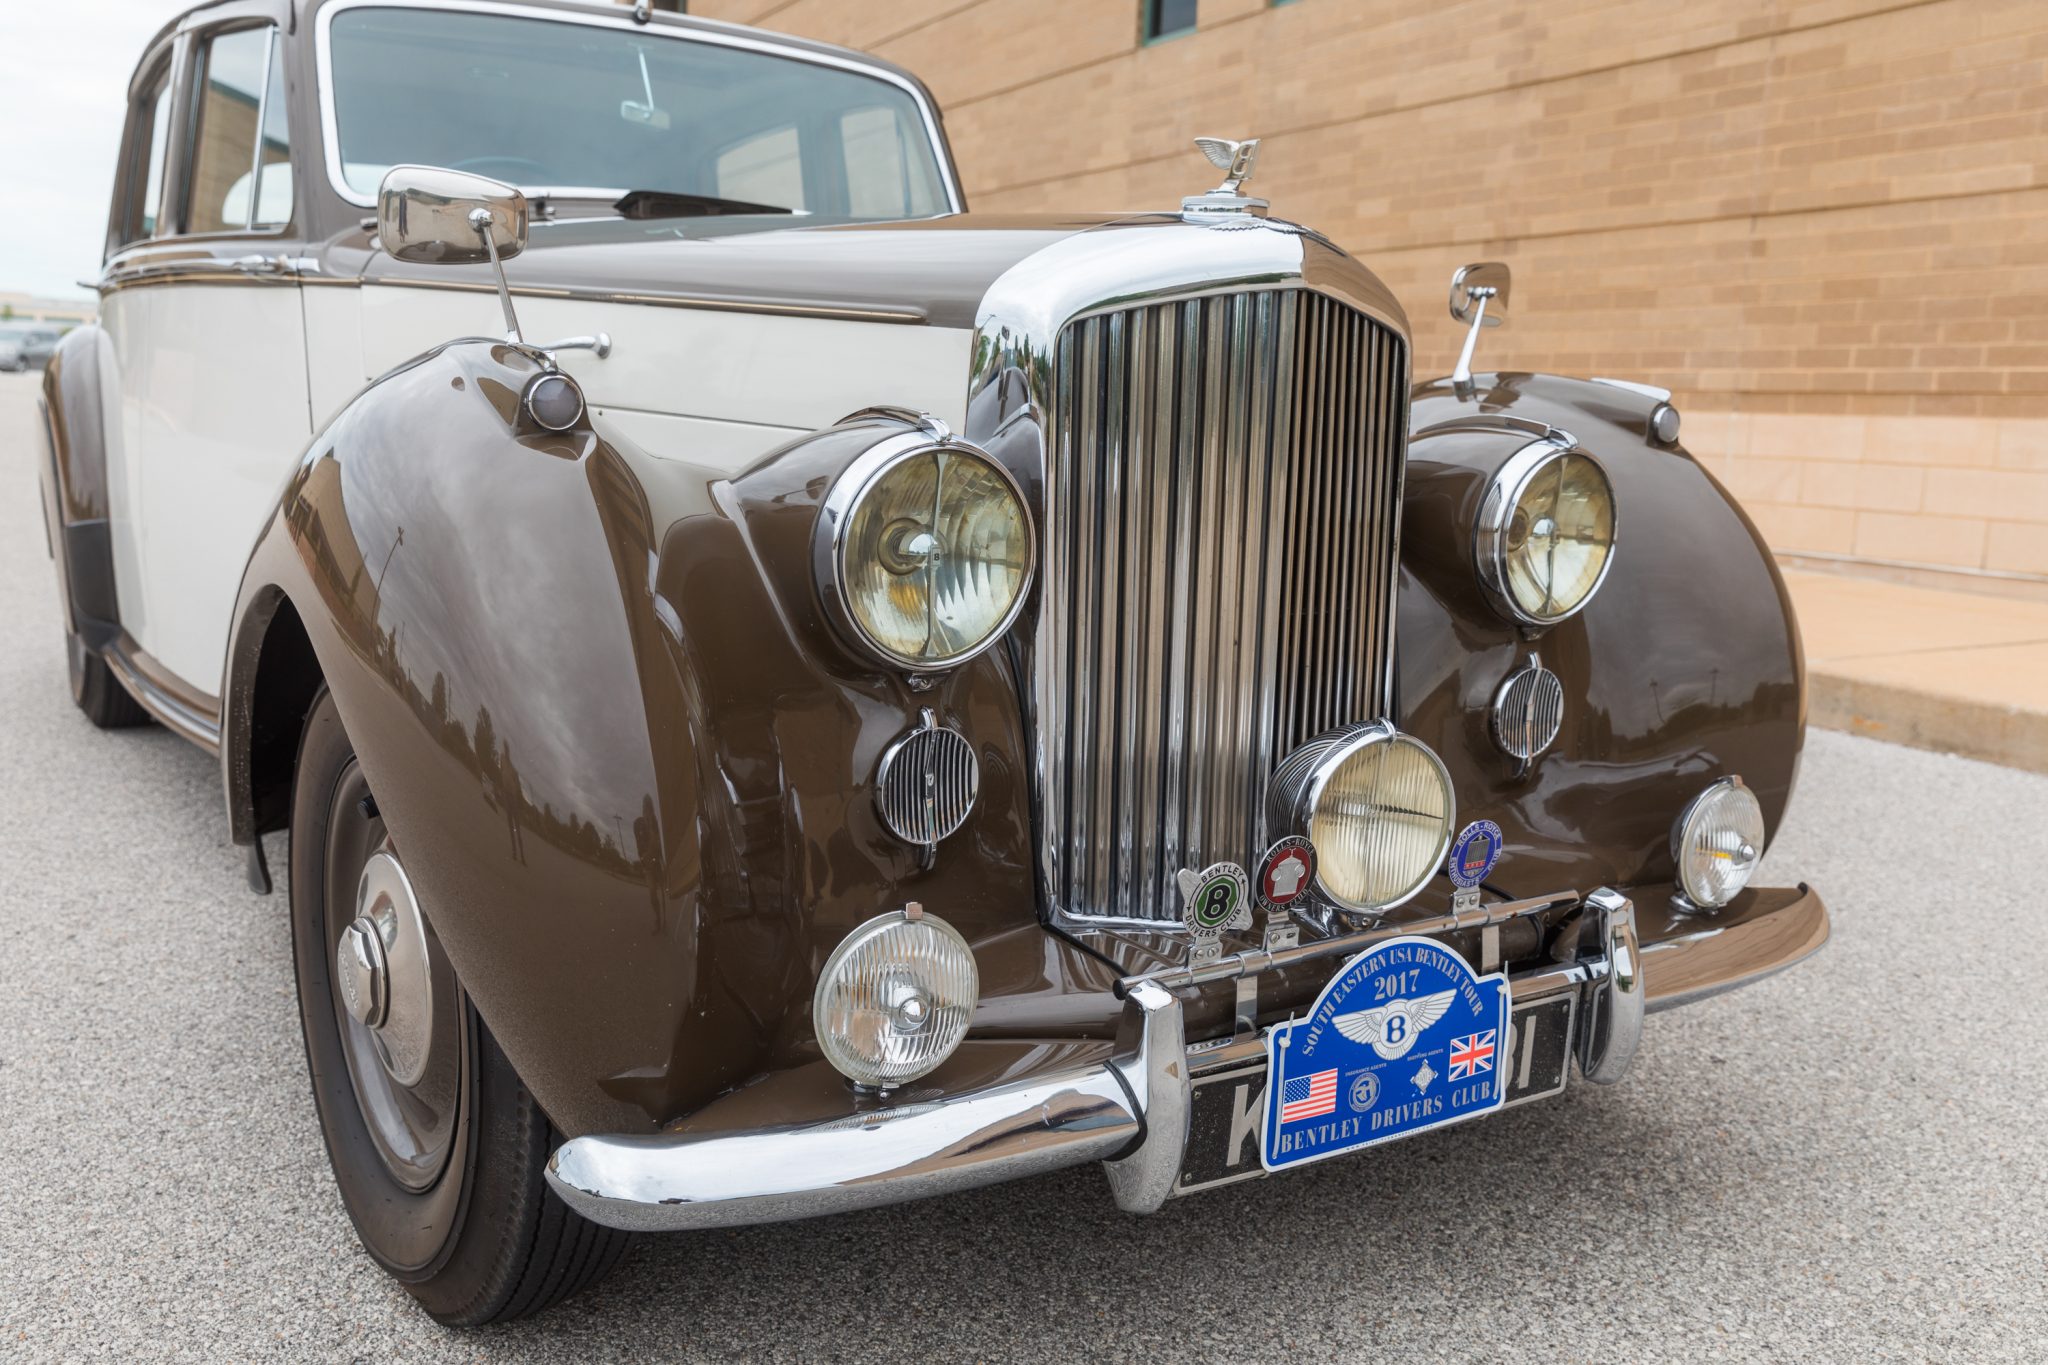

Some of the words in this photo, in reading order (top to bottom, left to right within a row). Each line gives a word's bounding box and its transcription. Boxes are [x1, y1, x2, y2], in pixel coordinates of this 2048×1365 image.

[1266, 838, 1315, 862] ROLLS-ROYCE
[1201, 864, 1244, 883] BENTLEY
[1202, 884, 1231, 919] B
[1259, 895, 1285, 912] OWNERS
[1185, 914, 1217, 938] DRIVERS
[1220, 908, 1242, 932] CLUB
[1374, 968, 1420, 1001] 2017
[1302, 1000, 1336, 1057] SOUTH
[1332, 952, 1387, 1004] EASTERN
[1389, 947, 1412, 965] USA
[1415, 947, 1463, 983] BENTLEY
[1460, 976, 1484, 1016] TOUR
[1386, 1015, 1406, 1043] B
[1281, 1116, 1362, 1153] BENTLEY
[1371, 1095, 1443, 1131] DRIVERS
[1451, 1081, 1490, 1108] CLUB
